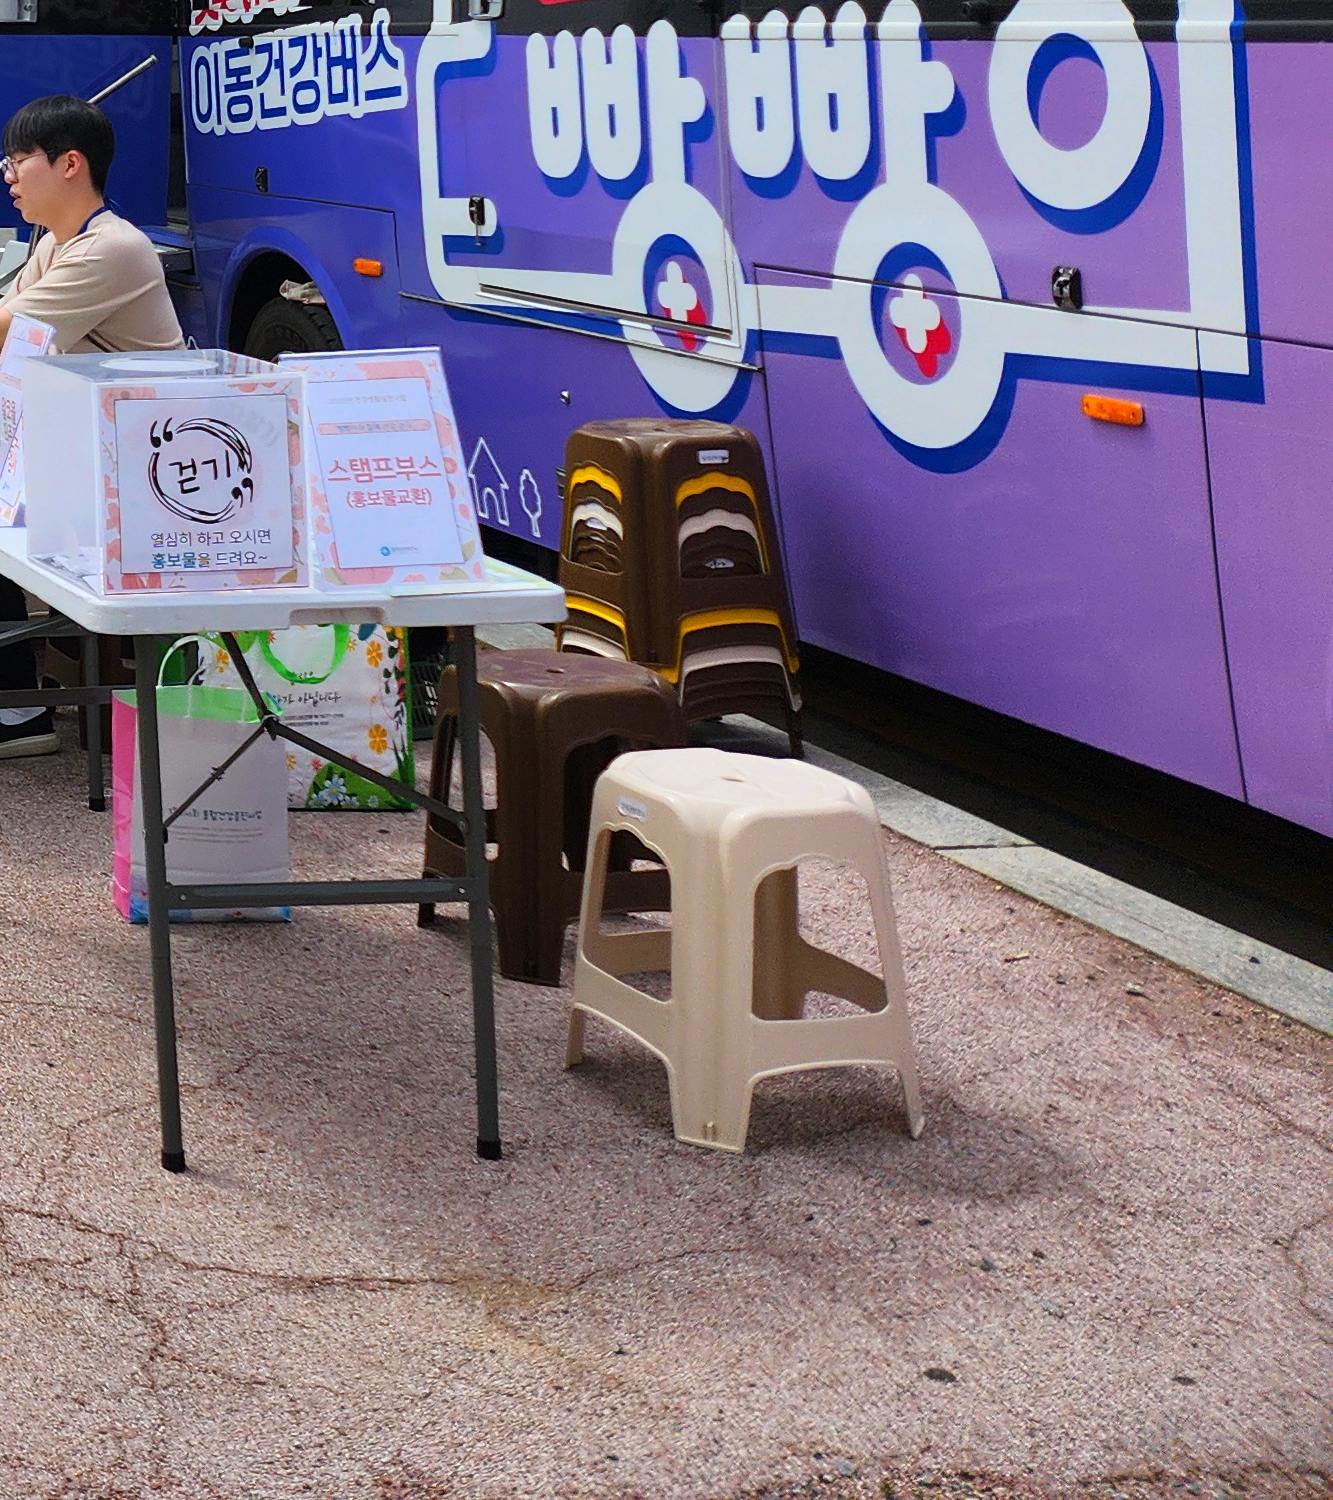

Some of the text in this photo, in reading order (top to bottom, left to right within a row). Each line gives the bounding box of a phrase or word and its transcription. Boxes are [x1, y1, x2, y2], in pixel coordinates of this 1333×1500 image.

[194, 17, 403, 128] 이동건강버스
[168, 449, 232, 495] 걷기
[328, 455, 442, 484] 스탬프부스
[346, 488, 432, 509] (홍보물교환)
[150, 529, 271, 548] 열심히 하고 오시면
[151, 550, 268, 569] 홍보물을 드려요~
